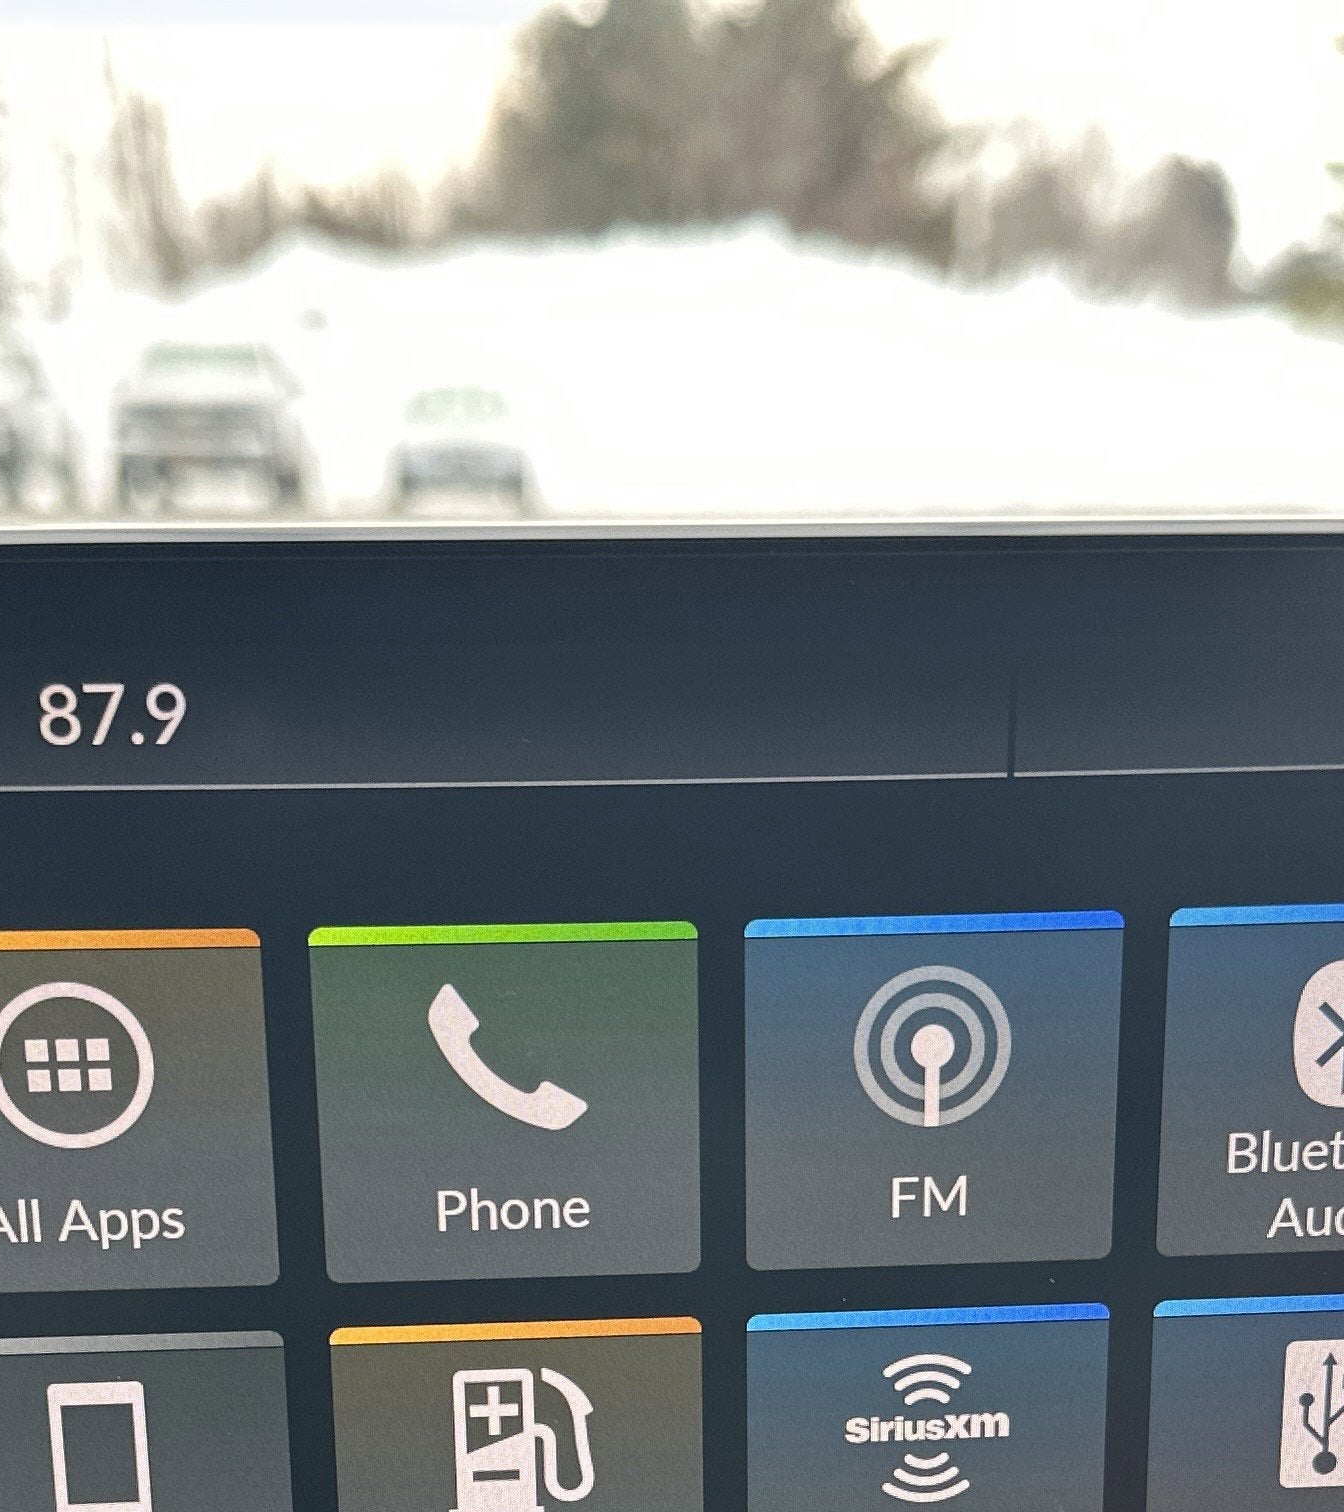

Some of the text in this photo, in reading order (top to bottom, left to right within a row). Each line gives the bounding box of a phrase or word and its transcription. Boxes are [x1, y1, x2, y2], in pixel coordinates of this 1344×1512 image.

[39, 683, 187, 746] 87.9
[436, 1187, 590, 1232] Phone
[891, 1175, 967, 1219] FM
[58, 1199, 186, 1250] Apps
